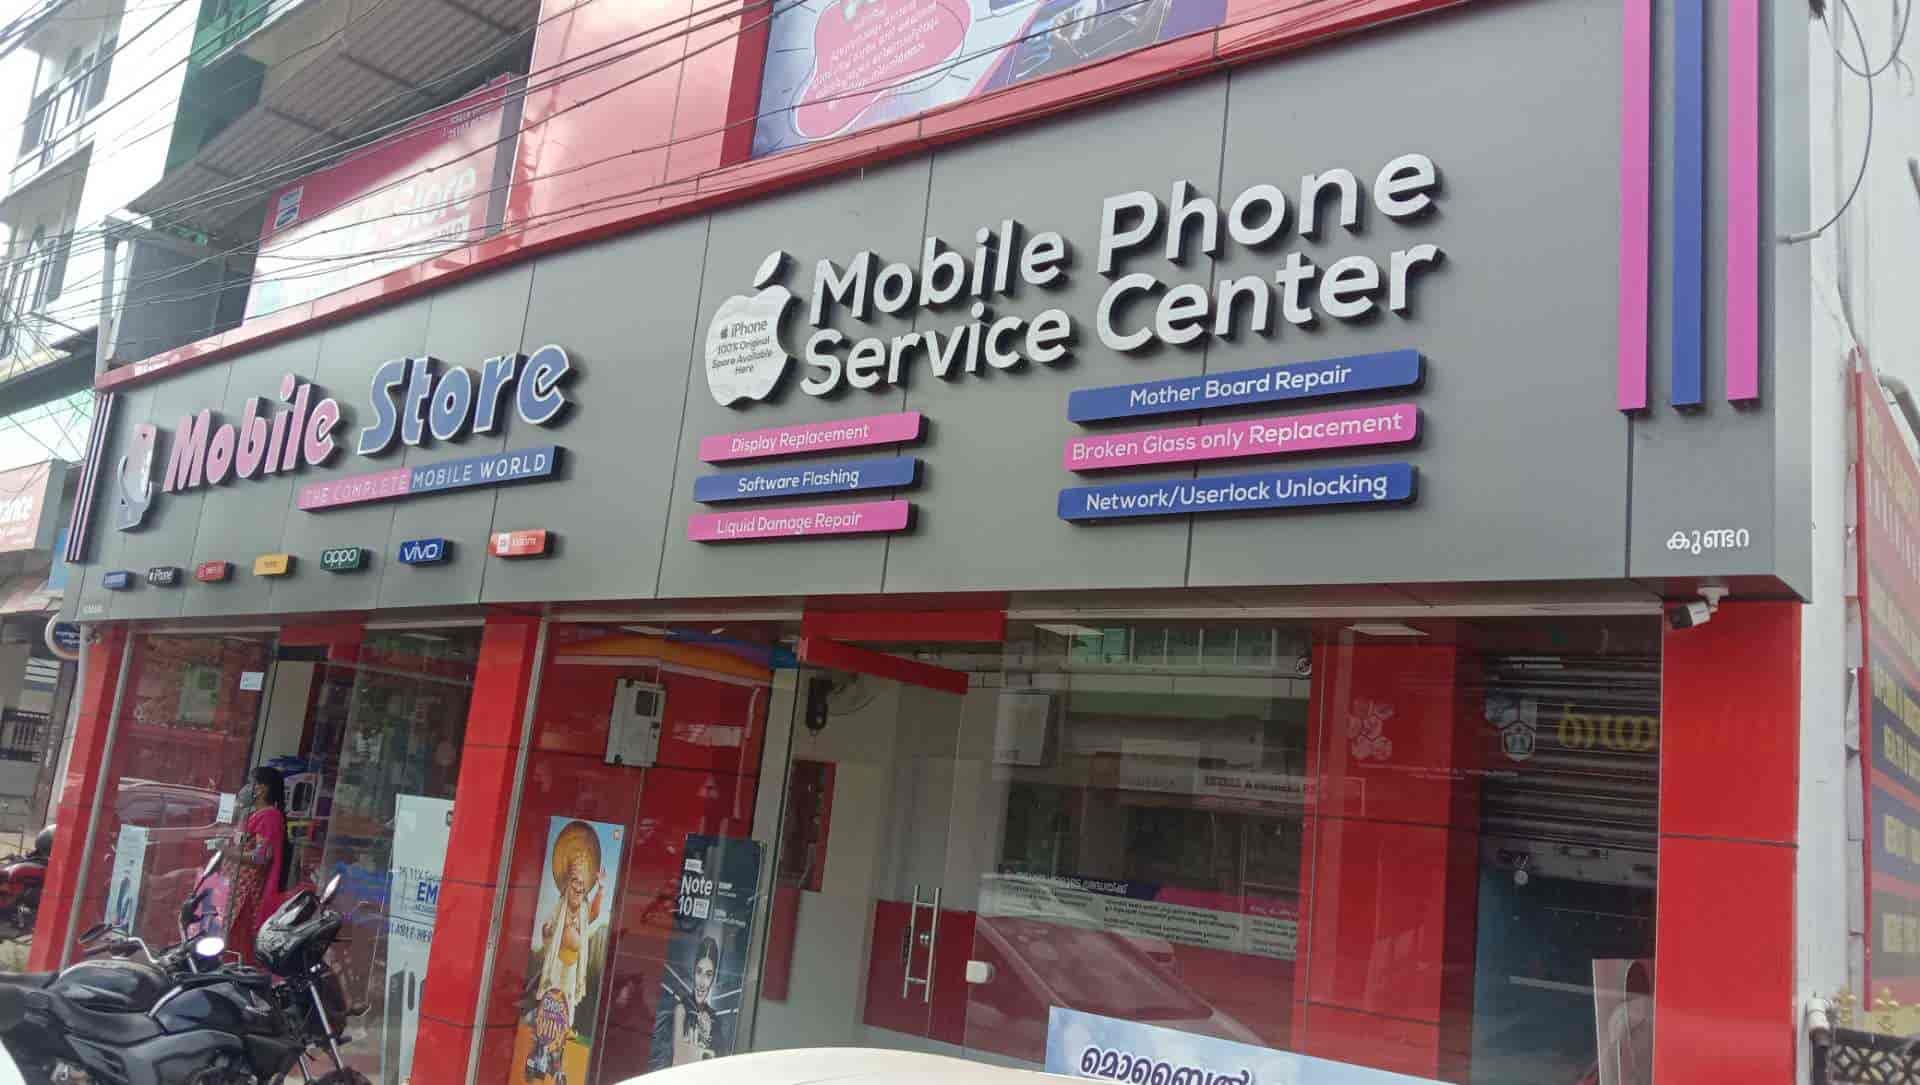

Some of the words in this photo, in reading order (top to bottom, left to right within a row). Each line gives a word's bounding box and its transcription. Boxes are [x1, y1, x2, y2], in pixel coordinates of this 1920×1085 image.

[809, 218, 1065, 327] Mobile
[1096, 152, 1436, 275] Phone
[731, 319, 769, 338] iPhone
[800, 302, 1071, 397] Service
[1096, 243, 1440, 353] Center
[1129, 383, 1201, 408] Mother
[1204, 373, 1270, 400] Board
[1275, 364, 1352, 395] Repair
[163, 373, 342, 494] Mobile
[357, 343, 569, 457] Store
[731, 431, 777, 454] Display
[779, 421, 870, 450] Replacement
[1072, 436, 1139, 462] Broken
[1142, 432, 1197, 456] Glass
[1200, 427, 1244, 453] only
[1248, 411, 1404, 445] Replacement
[304, 486, 330, 505] THE
[334, 470, 410, 502] COMPLETE
[412, 461, 473, 490] MOBILE
[479, 452, 547, 479] WORLD
[737, 473, 800, 494] Software
[802, 467, 860, 490] Flashing
[1085, 482, 1270, 512] Network/Userlock
[1275, 474, 1388, 501] Unlocking
[716, 514, 756, 536] Liquid
[758, 513, 812, 536] Damage
[815, 511, 862, 532] Repair
[1665, 528, 1750, 555] കുണ്ടറ
[416, 880, 439, 905] EM
[680, 875, 713, 896] Note
[678, 895, 693, 916] 10
